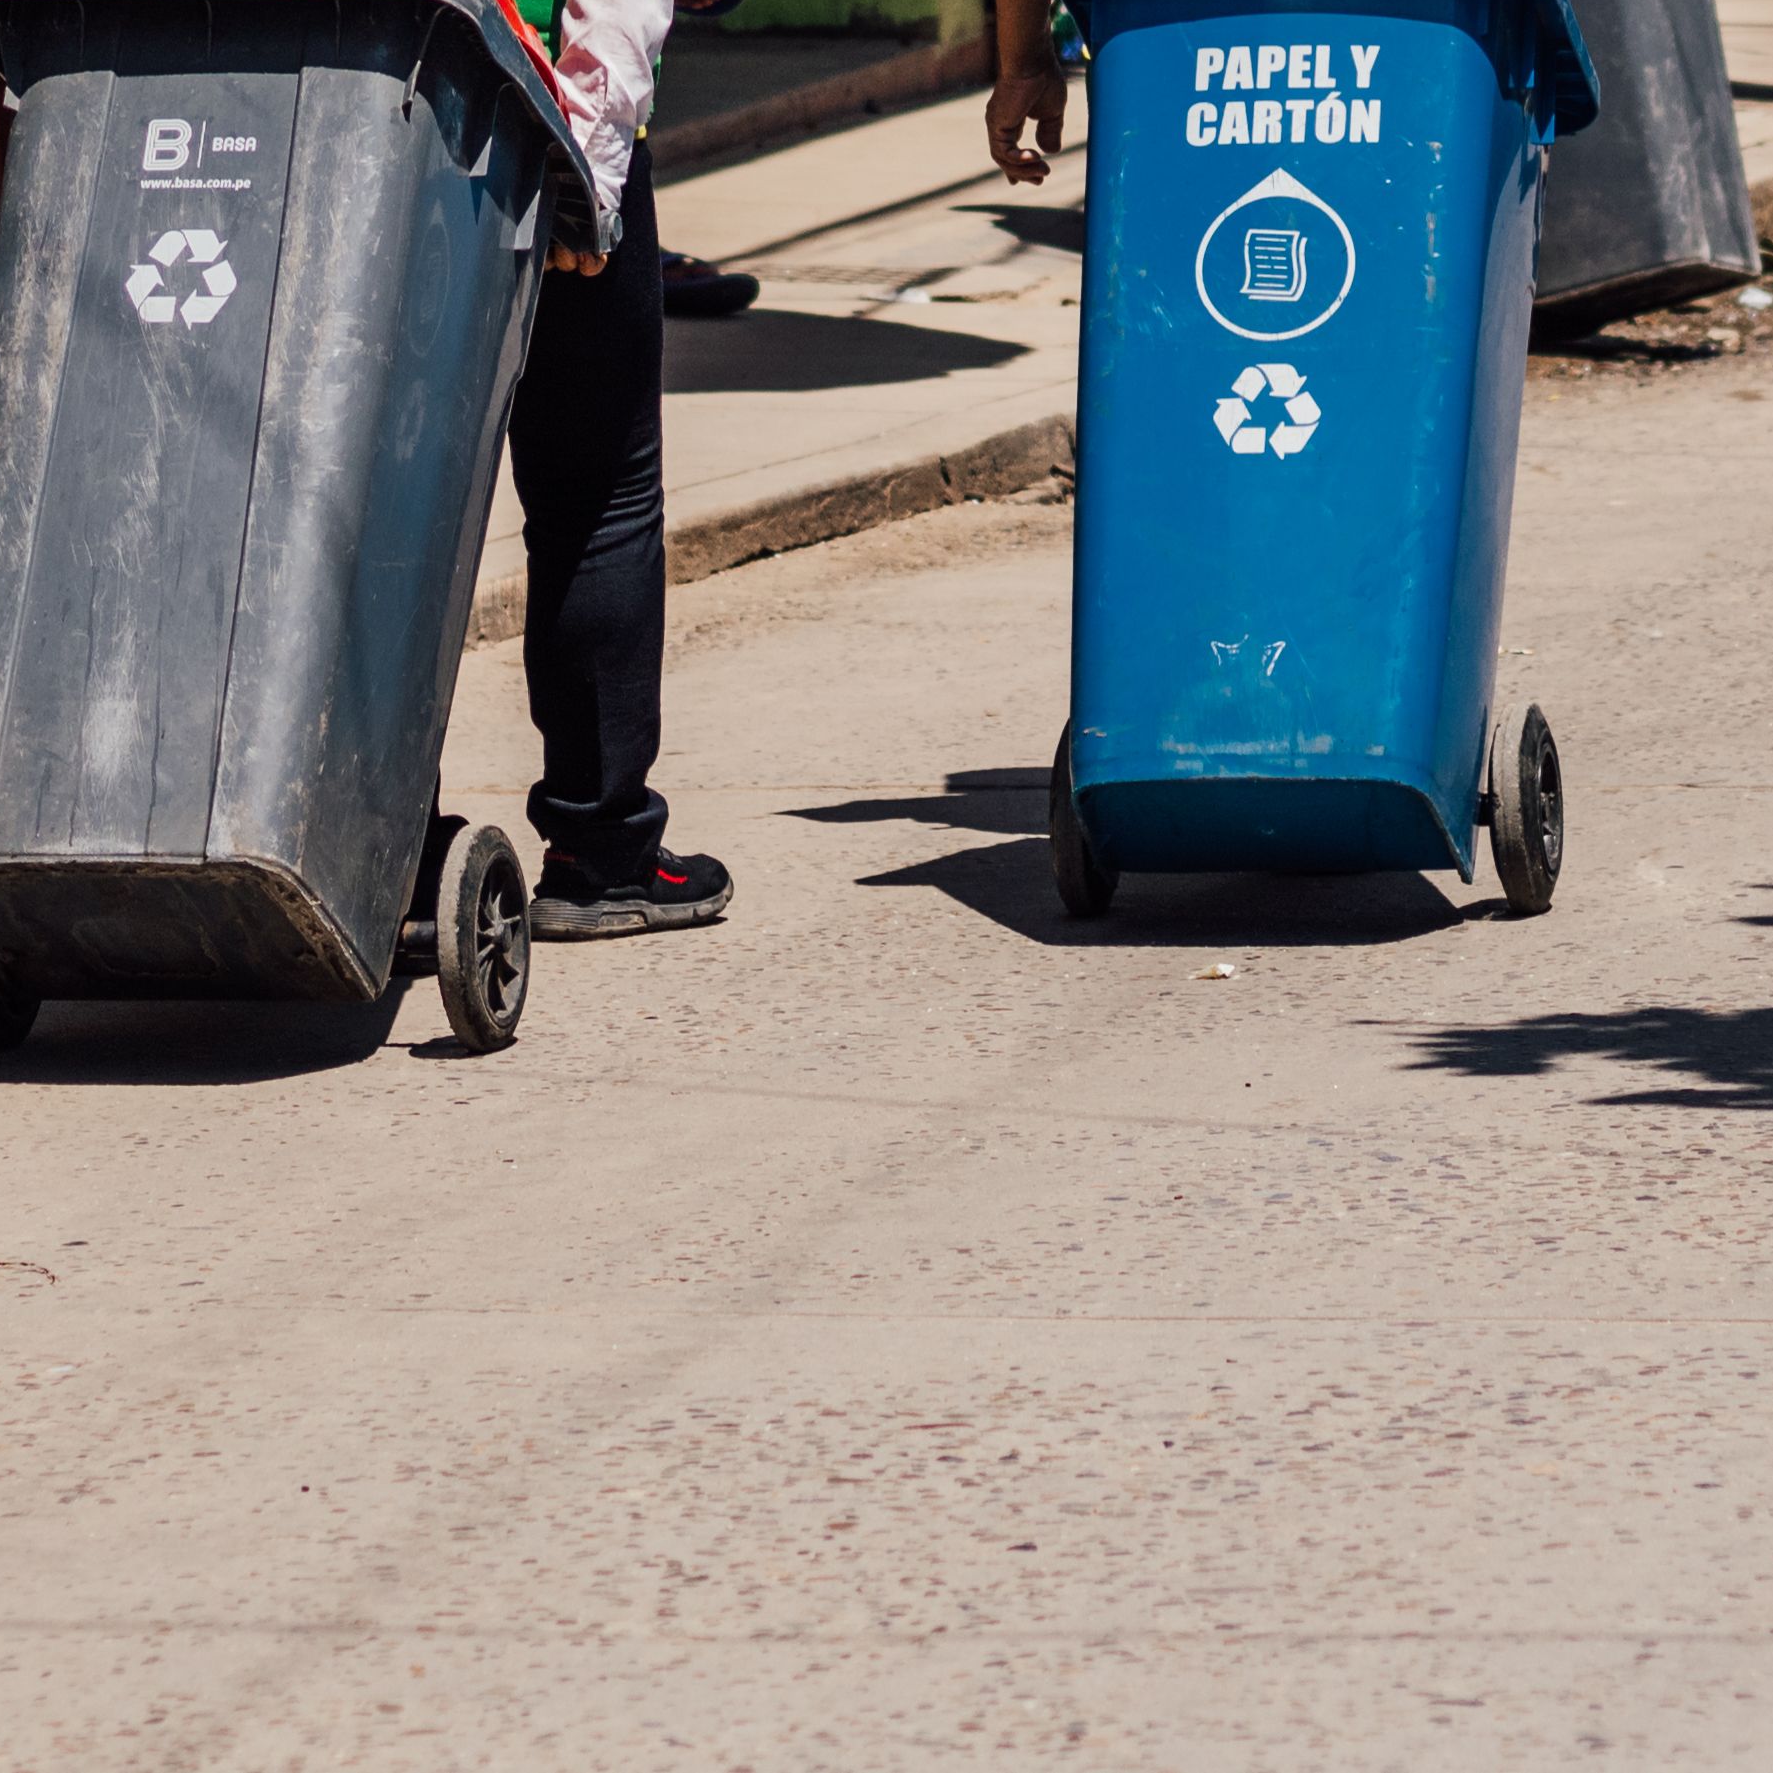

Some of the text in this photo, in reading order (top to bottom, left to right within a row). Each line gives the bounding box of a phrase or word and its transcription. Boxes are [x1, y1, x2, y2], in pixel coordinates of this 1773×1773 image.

[1194, 45, 1380, 91] PAPEL Y
[1186, 91, 1381, 147] CARTÓN
[142, 119, 257, 171] B BASA
[140, 176, 251, 191] www.basa.com.pe
